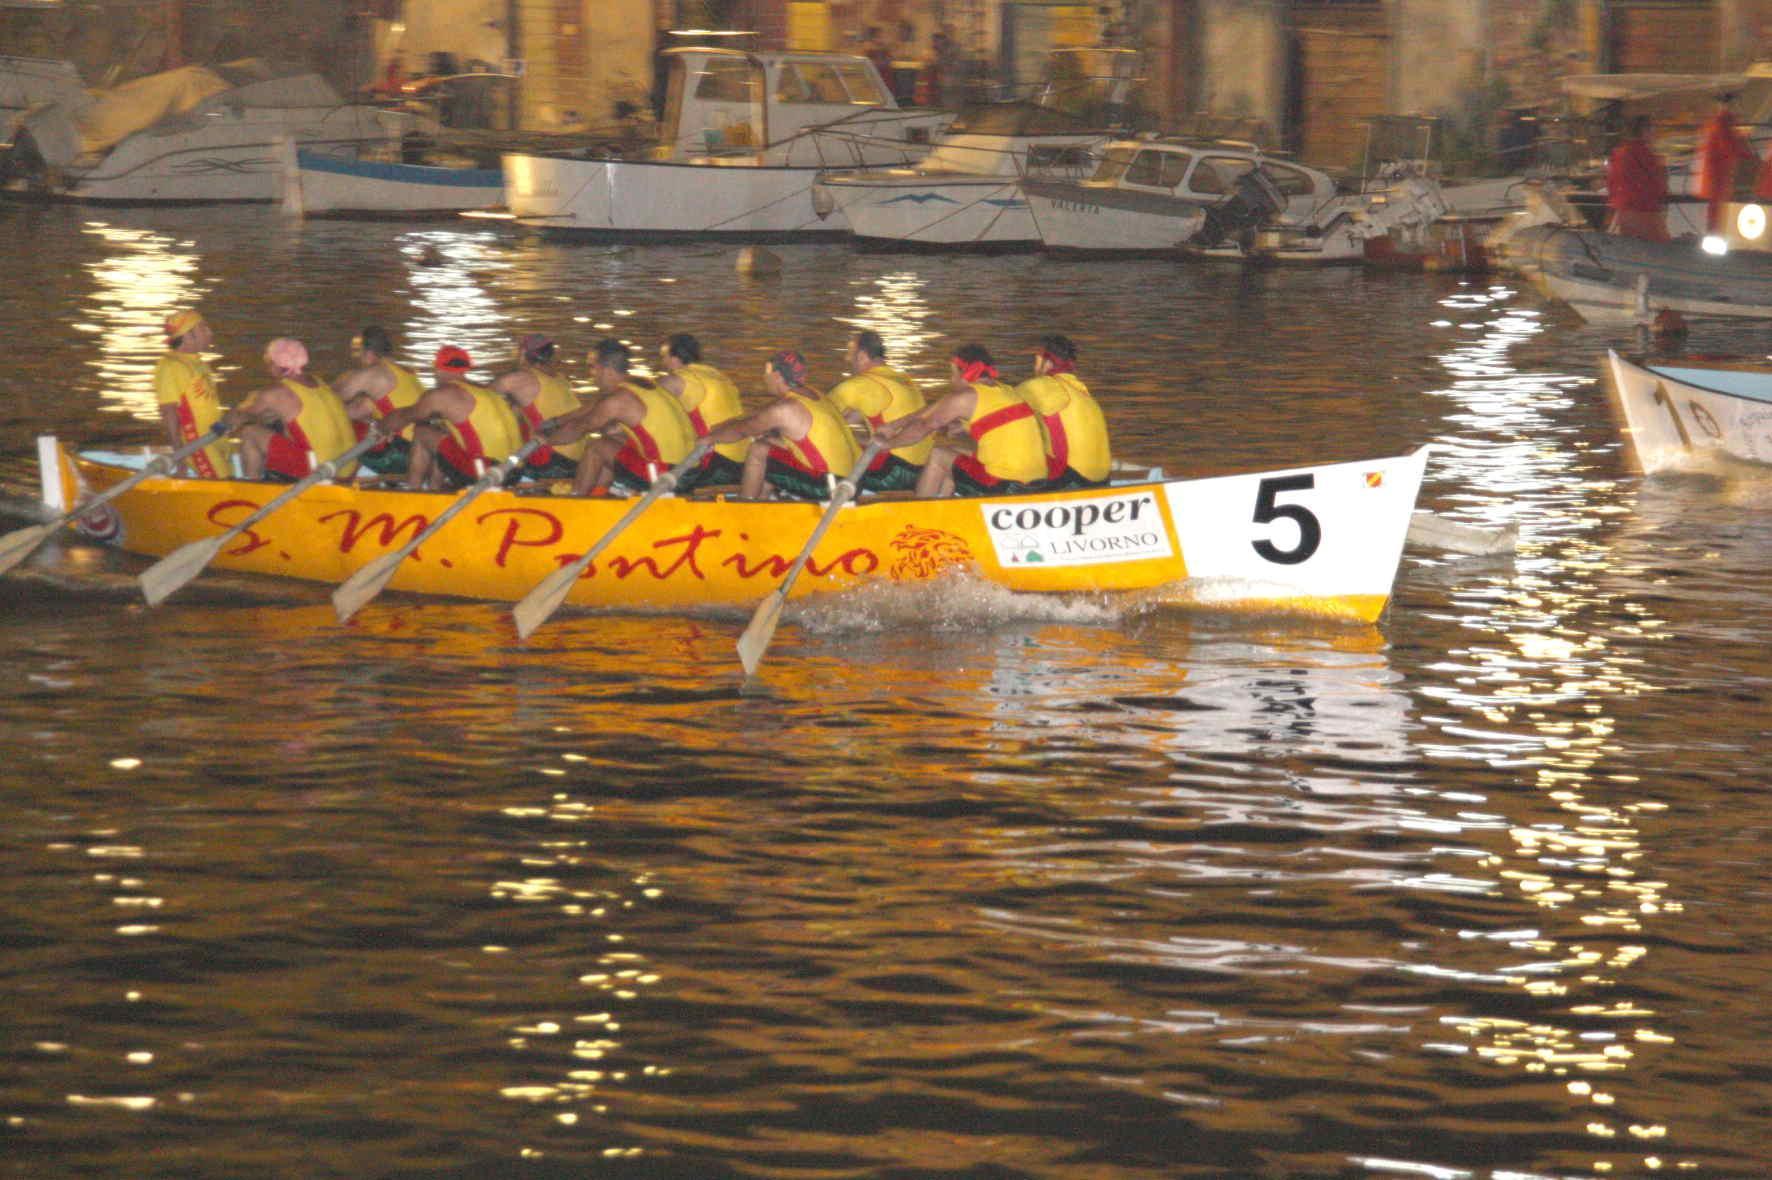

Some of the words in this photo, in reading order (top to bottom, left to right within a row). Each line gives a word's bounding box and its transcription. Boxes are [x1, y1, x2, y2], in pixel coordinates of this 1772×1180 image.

[990, 497, 1152, 536] cooper
[1251, 473, 1322, 565] 5
[1050, 532, 1159, 555] LIVORNO
